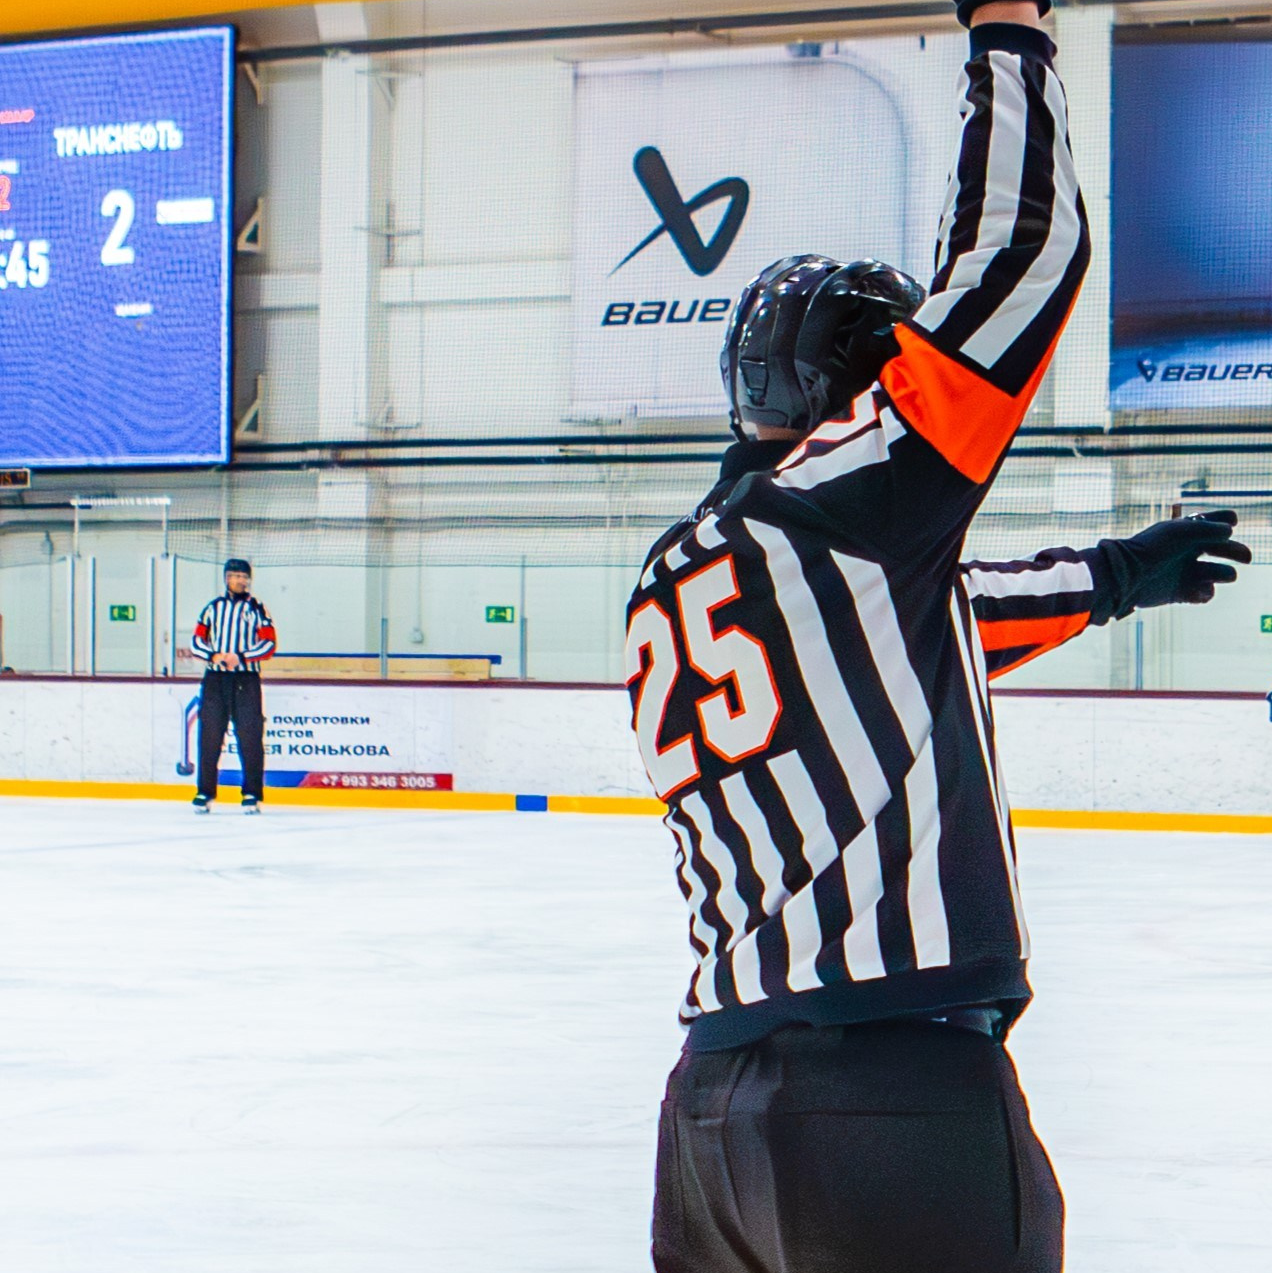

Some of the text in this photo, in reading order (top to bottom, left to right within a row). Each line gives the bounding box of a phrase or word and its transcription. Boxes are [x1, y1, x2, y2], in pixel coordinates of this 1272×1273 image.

[53, 120, 183, 157] ТРАНСНЕФТЬ
[100, 189, 135, 266] 2
[601, 298, 731, 326] BAUE
[624, 552, 783, 802] 25
[273, 716, 370, 725] подготовки
[288, 744, 390, 757] КОНЬКОВА
[341, 775, 368, 787] 993
